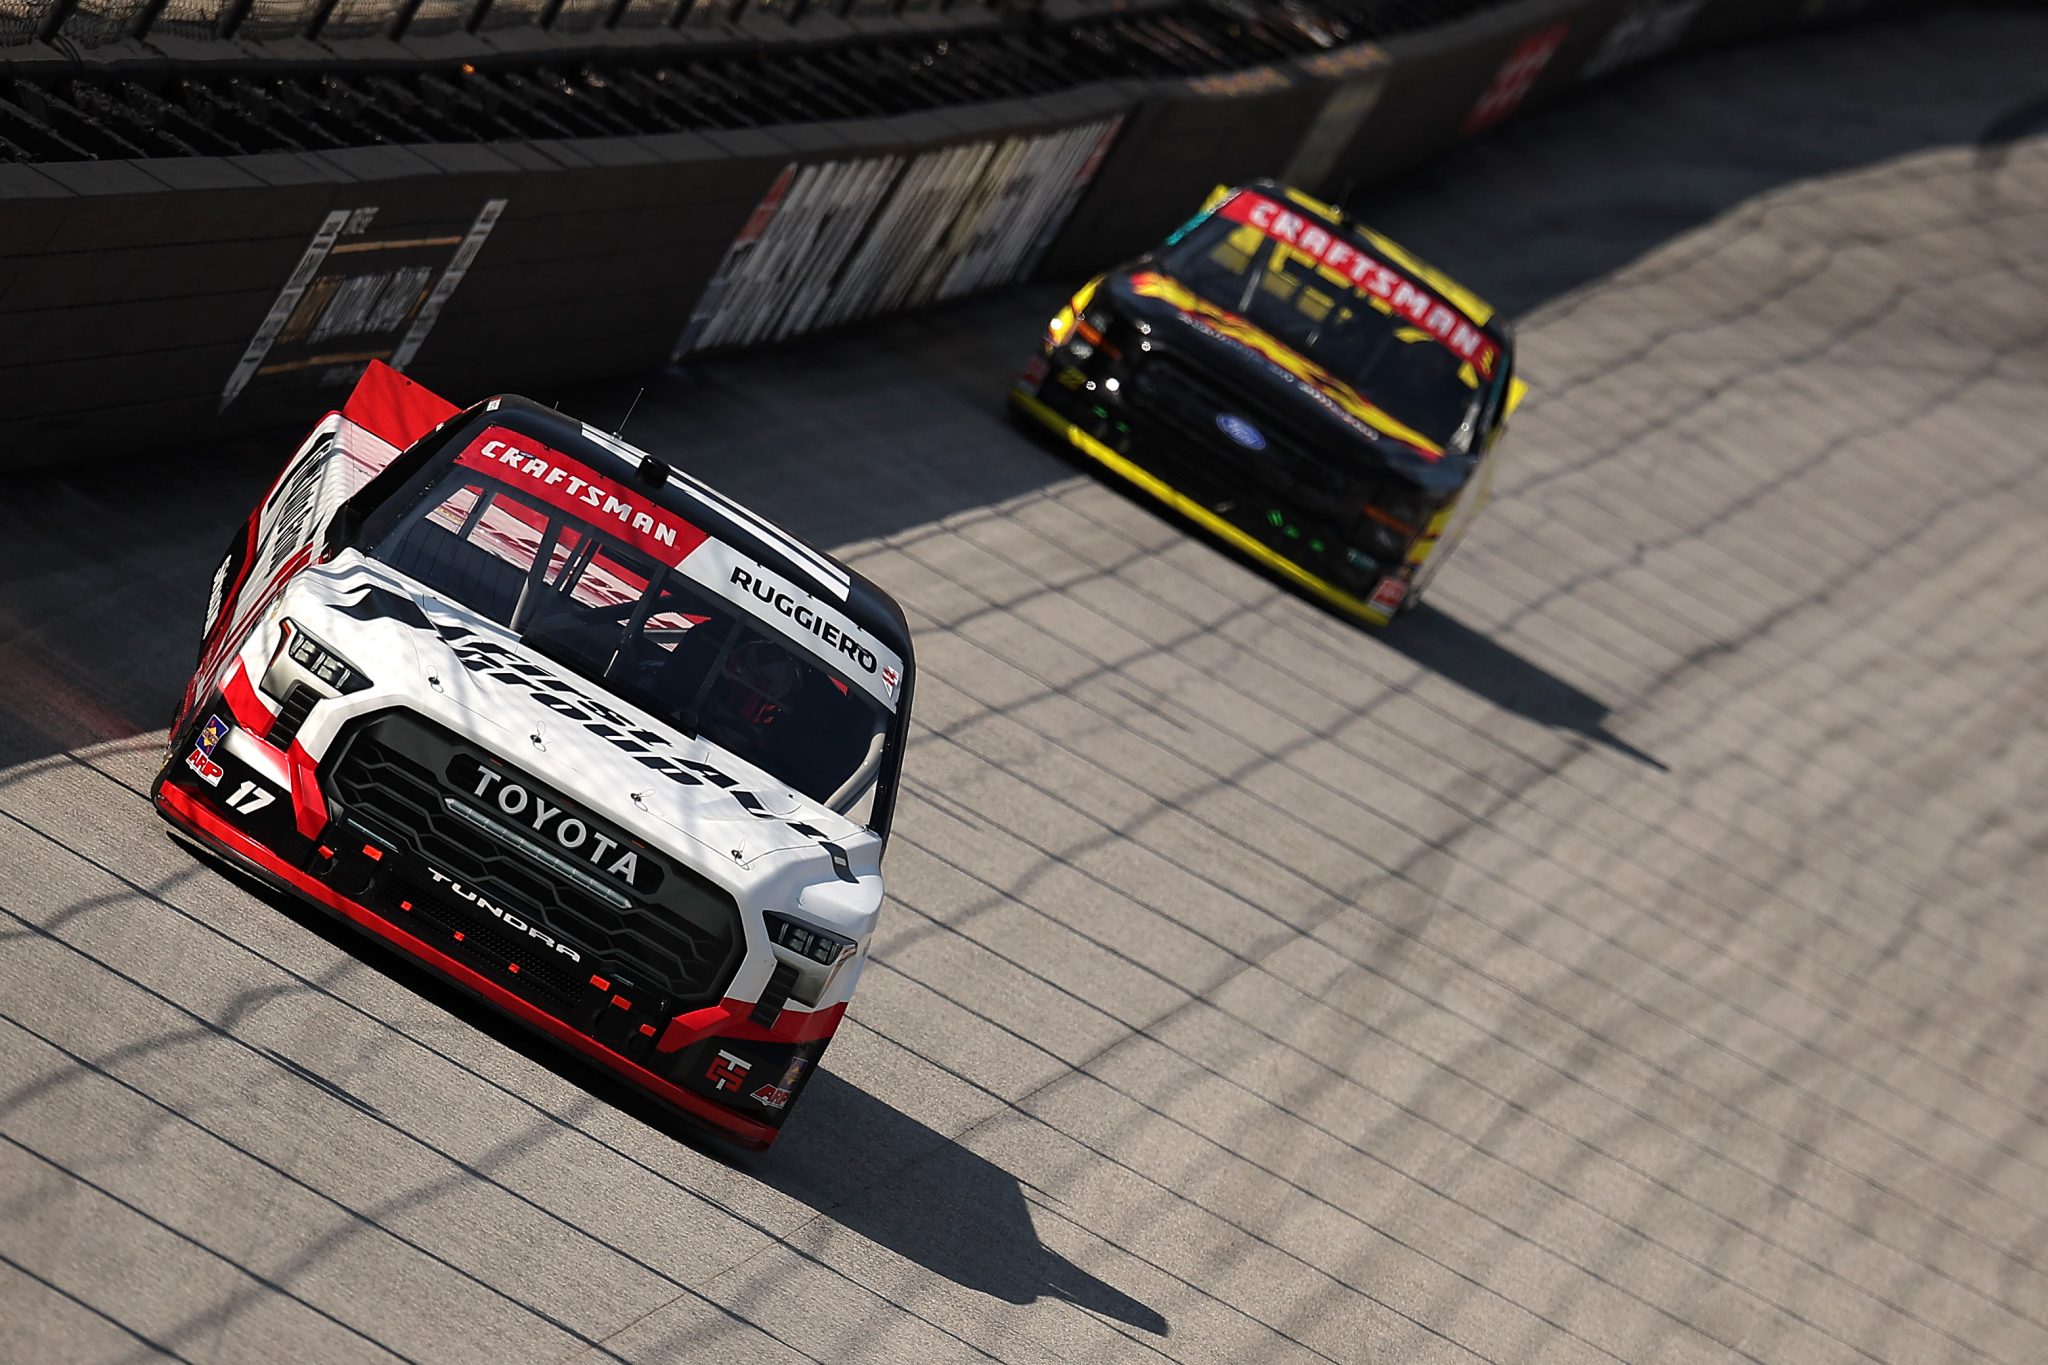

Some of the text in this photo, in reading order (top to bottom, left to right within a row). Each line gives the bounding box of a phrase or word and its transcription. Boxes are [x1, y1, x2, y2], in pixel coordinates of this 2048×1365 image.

[1247, 200, 1482, 358] CRAFTSMAN
[480, 440, 678, 547] CRAFTSMAN
[729, 565, 877, 674] RUGGIERO
[188, 749, 223, 780] ARP
[225, 780, 276, 815] 17
[473, 765, 638, 886] TOYOTA
[427, 866, 581, 963] TUNDRA
